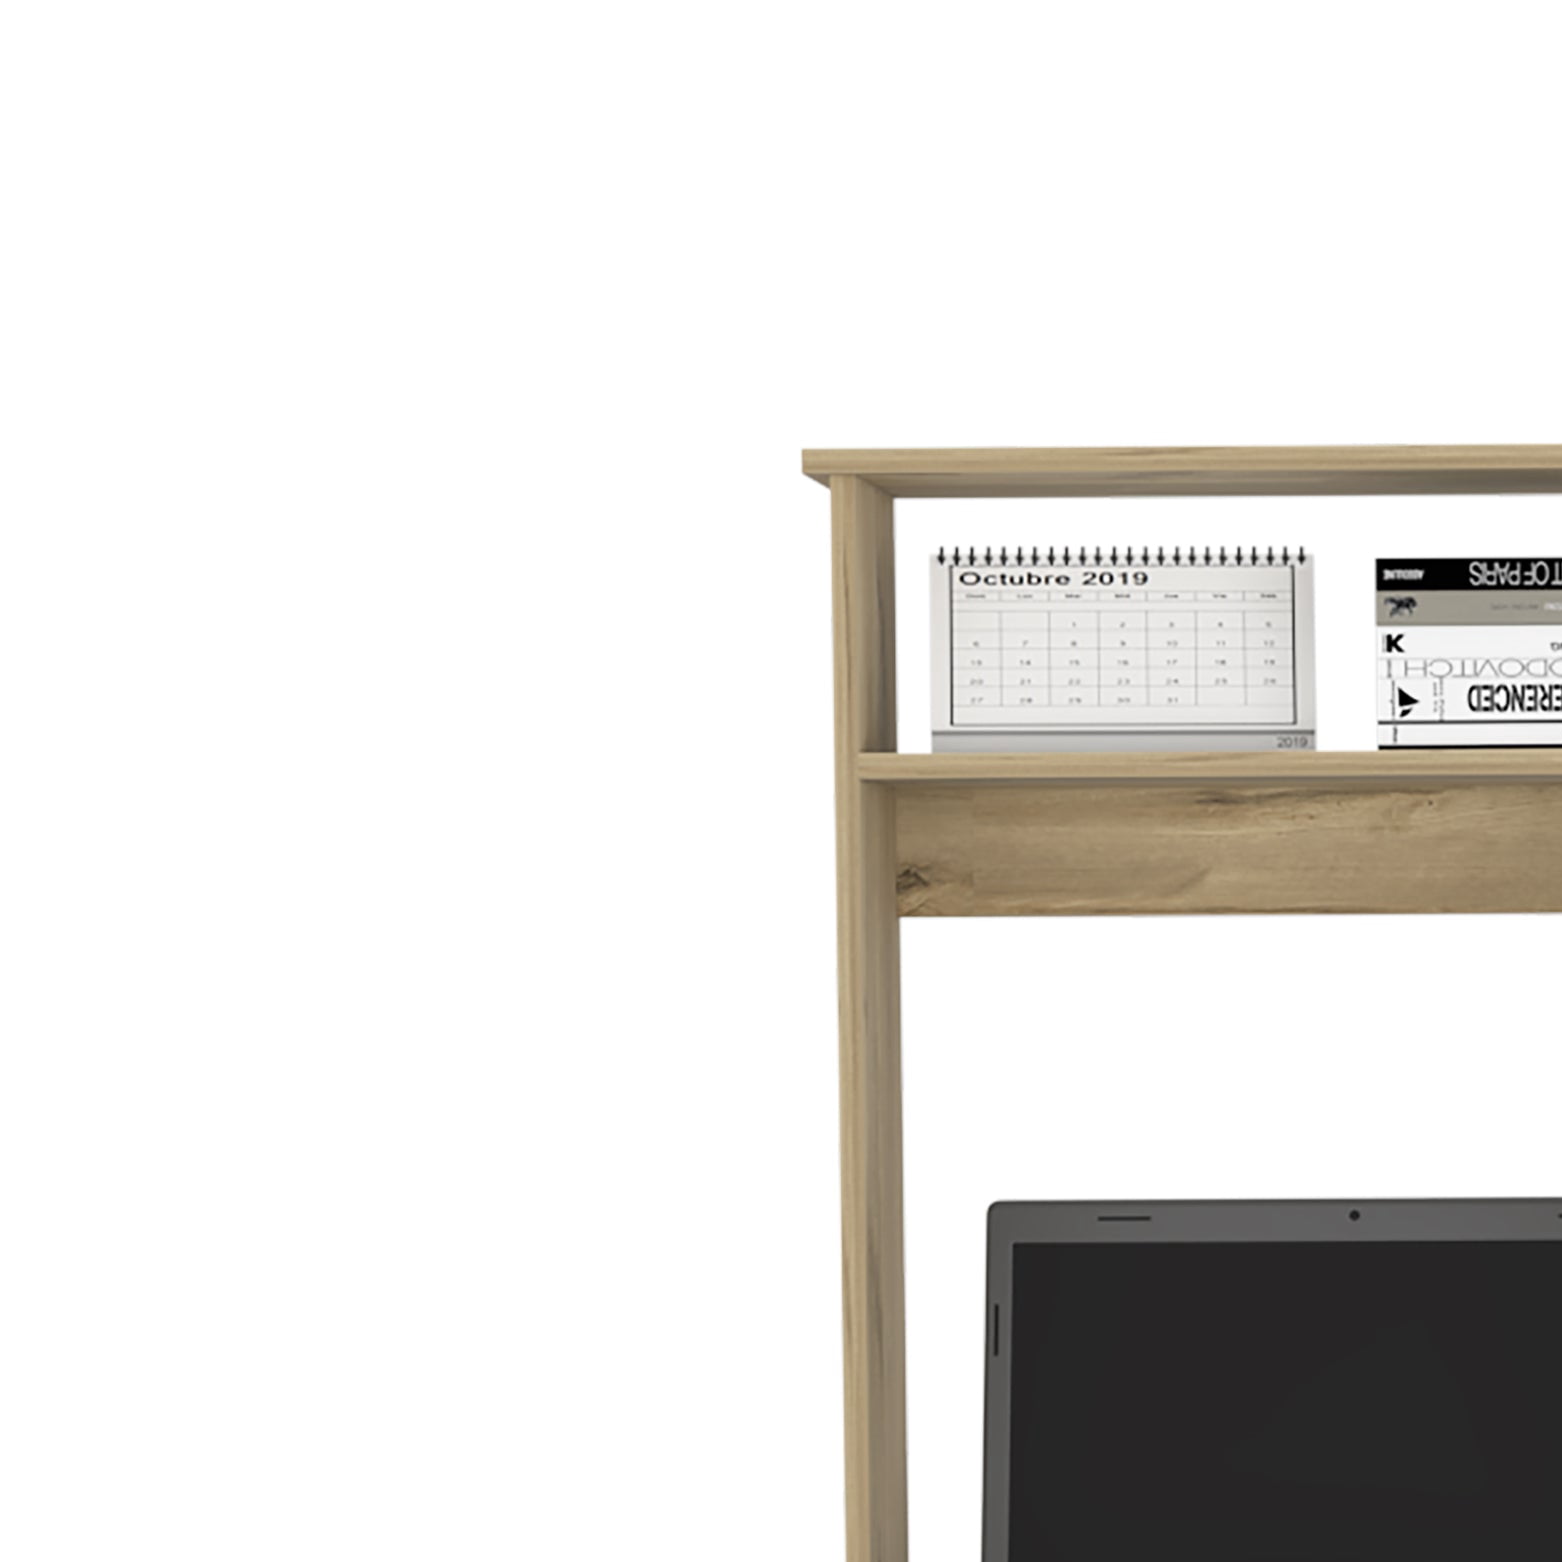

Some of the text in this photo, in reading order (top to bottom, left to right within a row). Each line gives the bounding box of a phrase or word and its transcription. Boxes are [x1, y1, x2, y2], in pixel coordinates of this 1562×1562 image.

[959, 571, 1149, 586] Octubre 2019
[1469, 561, 1520, 585] PARIS
[1523, 561, 1549, 585] OF
[1386, 634, 1405, 653] K
[1277, 737, 1308, 748] 2019
